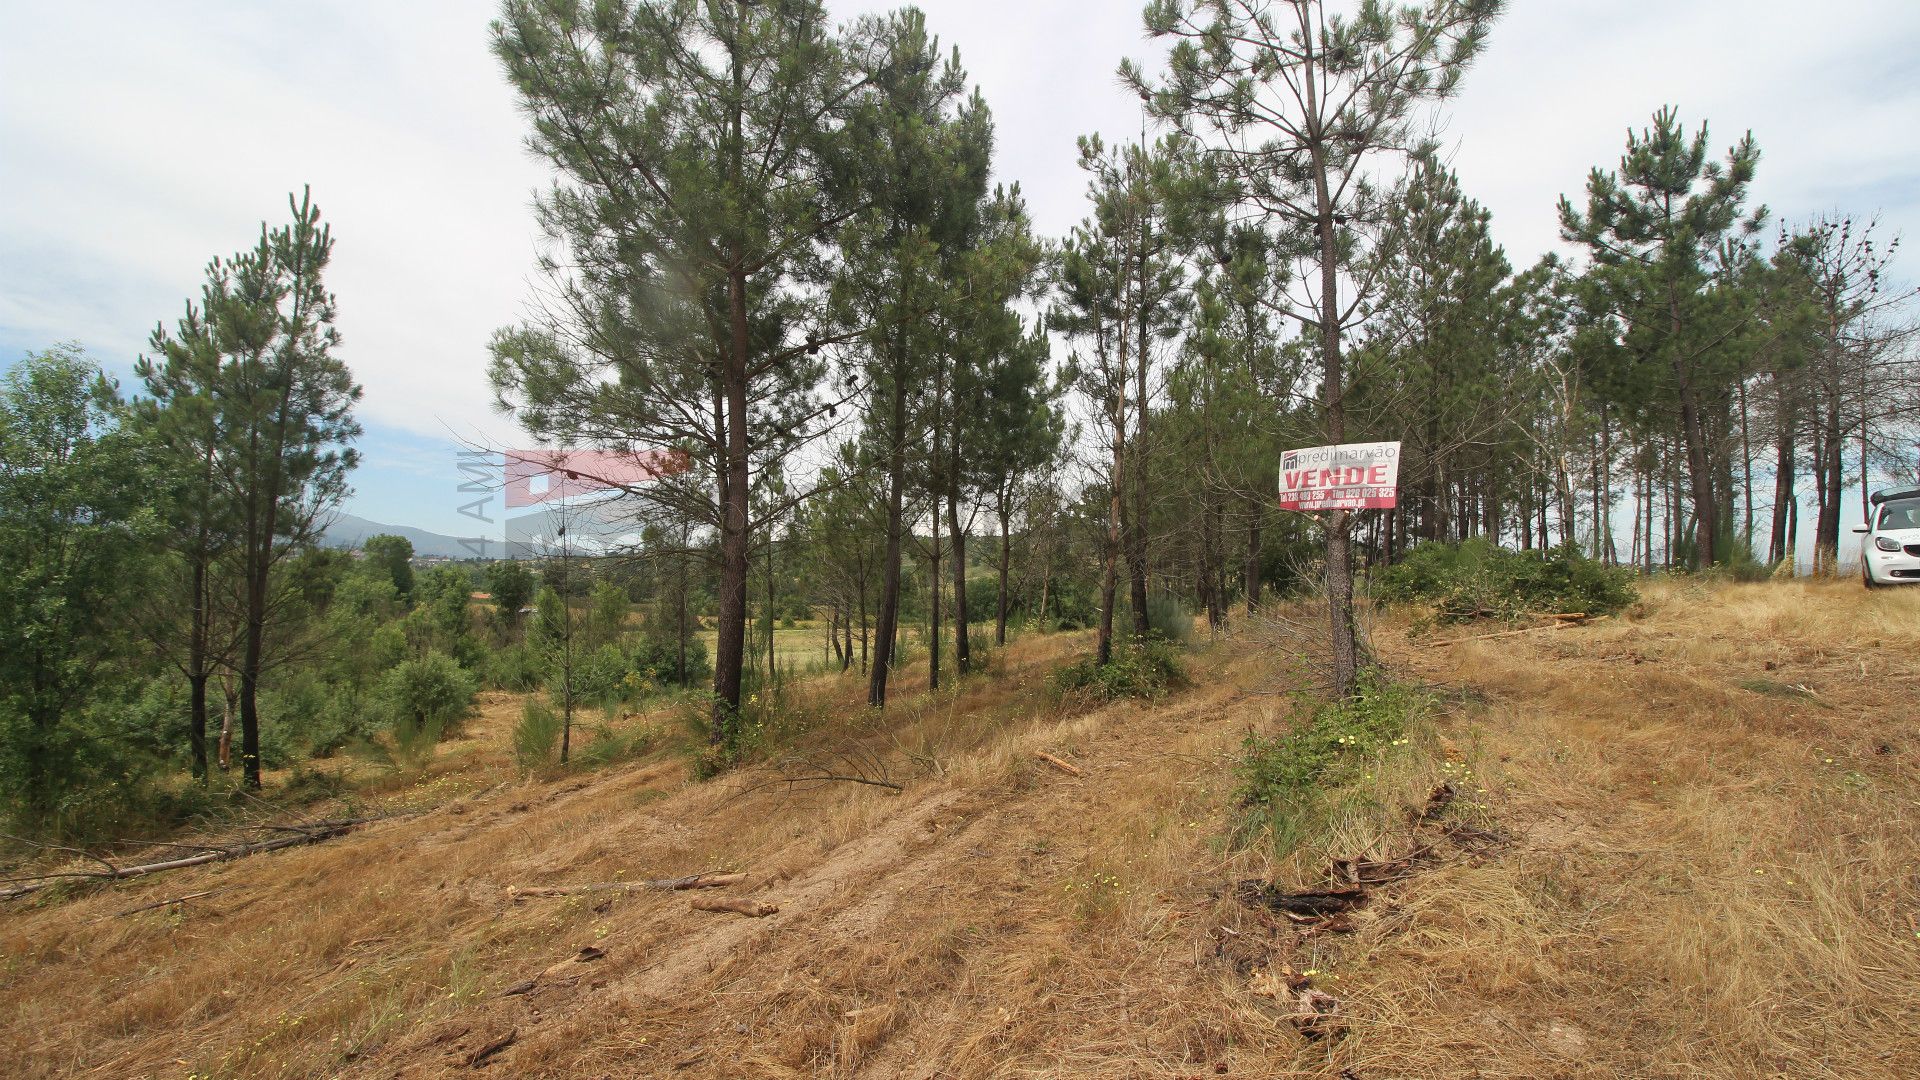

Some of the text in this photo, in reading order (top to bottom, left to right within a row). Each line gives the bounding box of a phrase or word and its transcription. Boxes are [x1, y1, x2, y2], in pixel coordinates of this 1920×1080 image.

[1298, 446, 1396, 465] predimarvão
[1285, 464, 1388, 490] VENDE
[1379, 487, 1395, 498] 325
